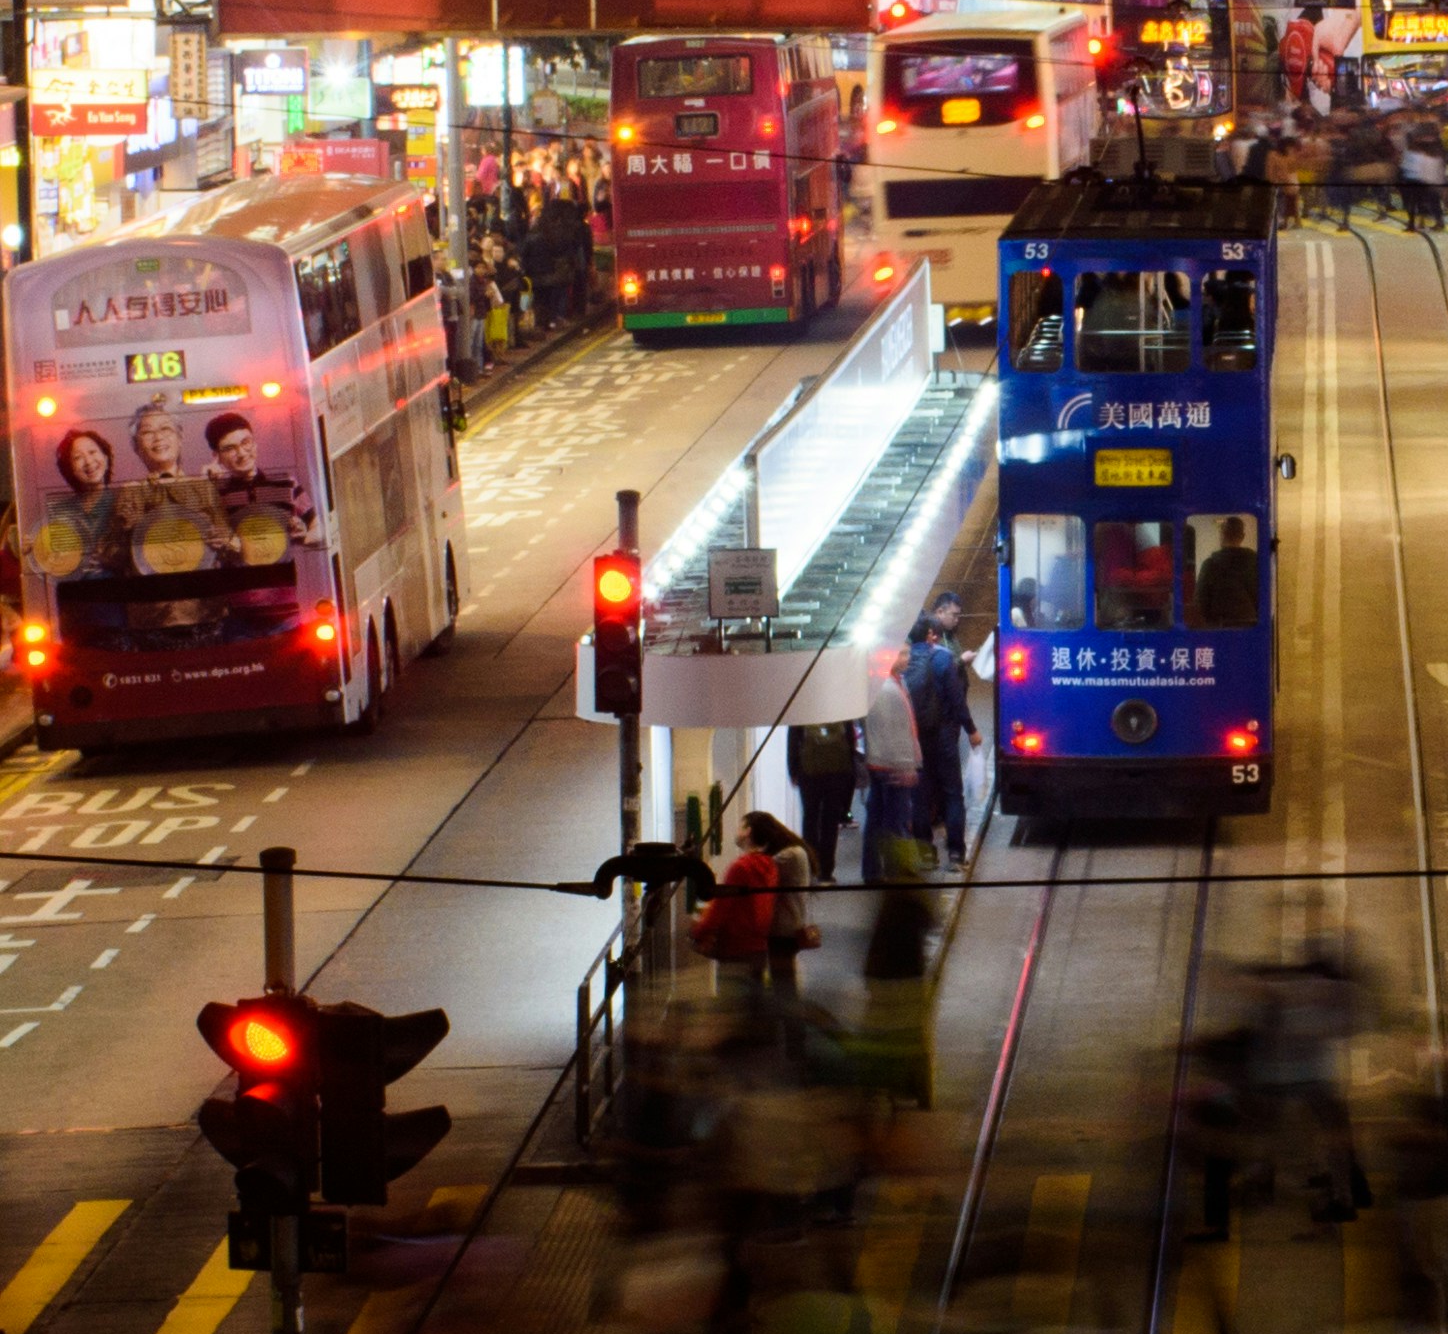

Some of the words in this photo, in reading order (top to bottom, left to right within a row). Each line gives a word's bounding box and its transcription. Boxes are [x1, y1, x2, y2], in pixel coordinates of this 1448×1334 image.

[626, 153, 694, 177] 周大福
[1024, 242, 1049, 260] 53
[1222, 242, 1245, 260] 53
[131, 351, 182, 382] 116
[1099, 400, 1213, 431] 美國萬通
[1050, 674, 1217, 687] www.massmutualasia.com
[1231, 764, 1260, 785] 53
[0, 783, 238, 821] BUS
